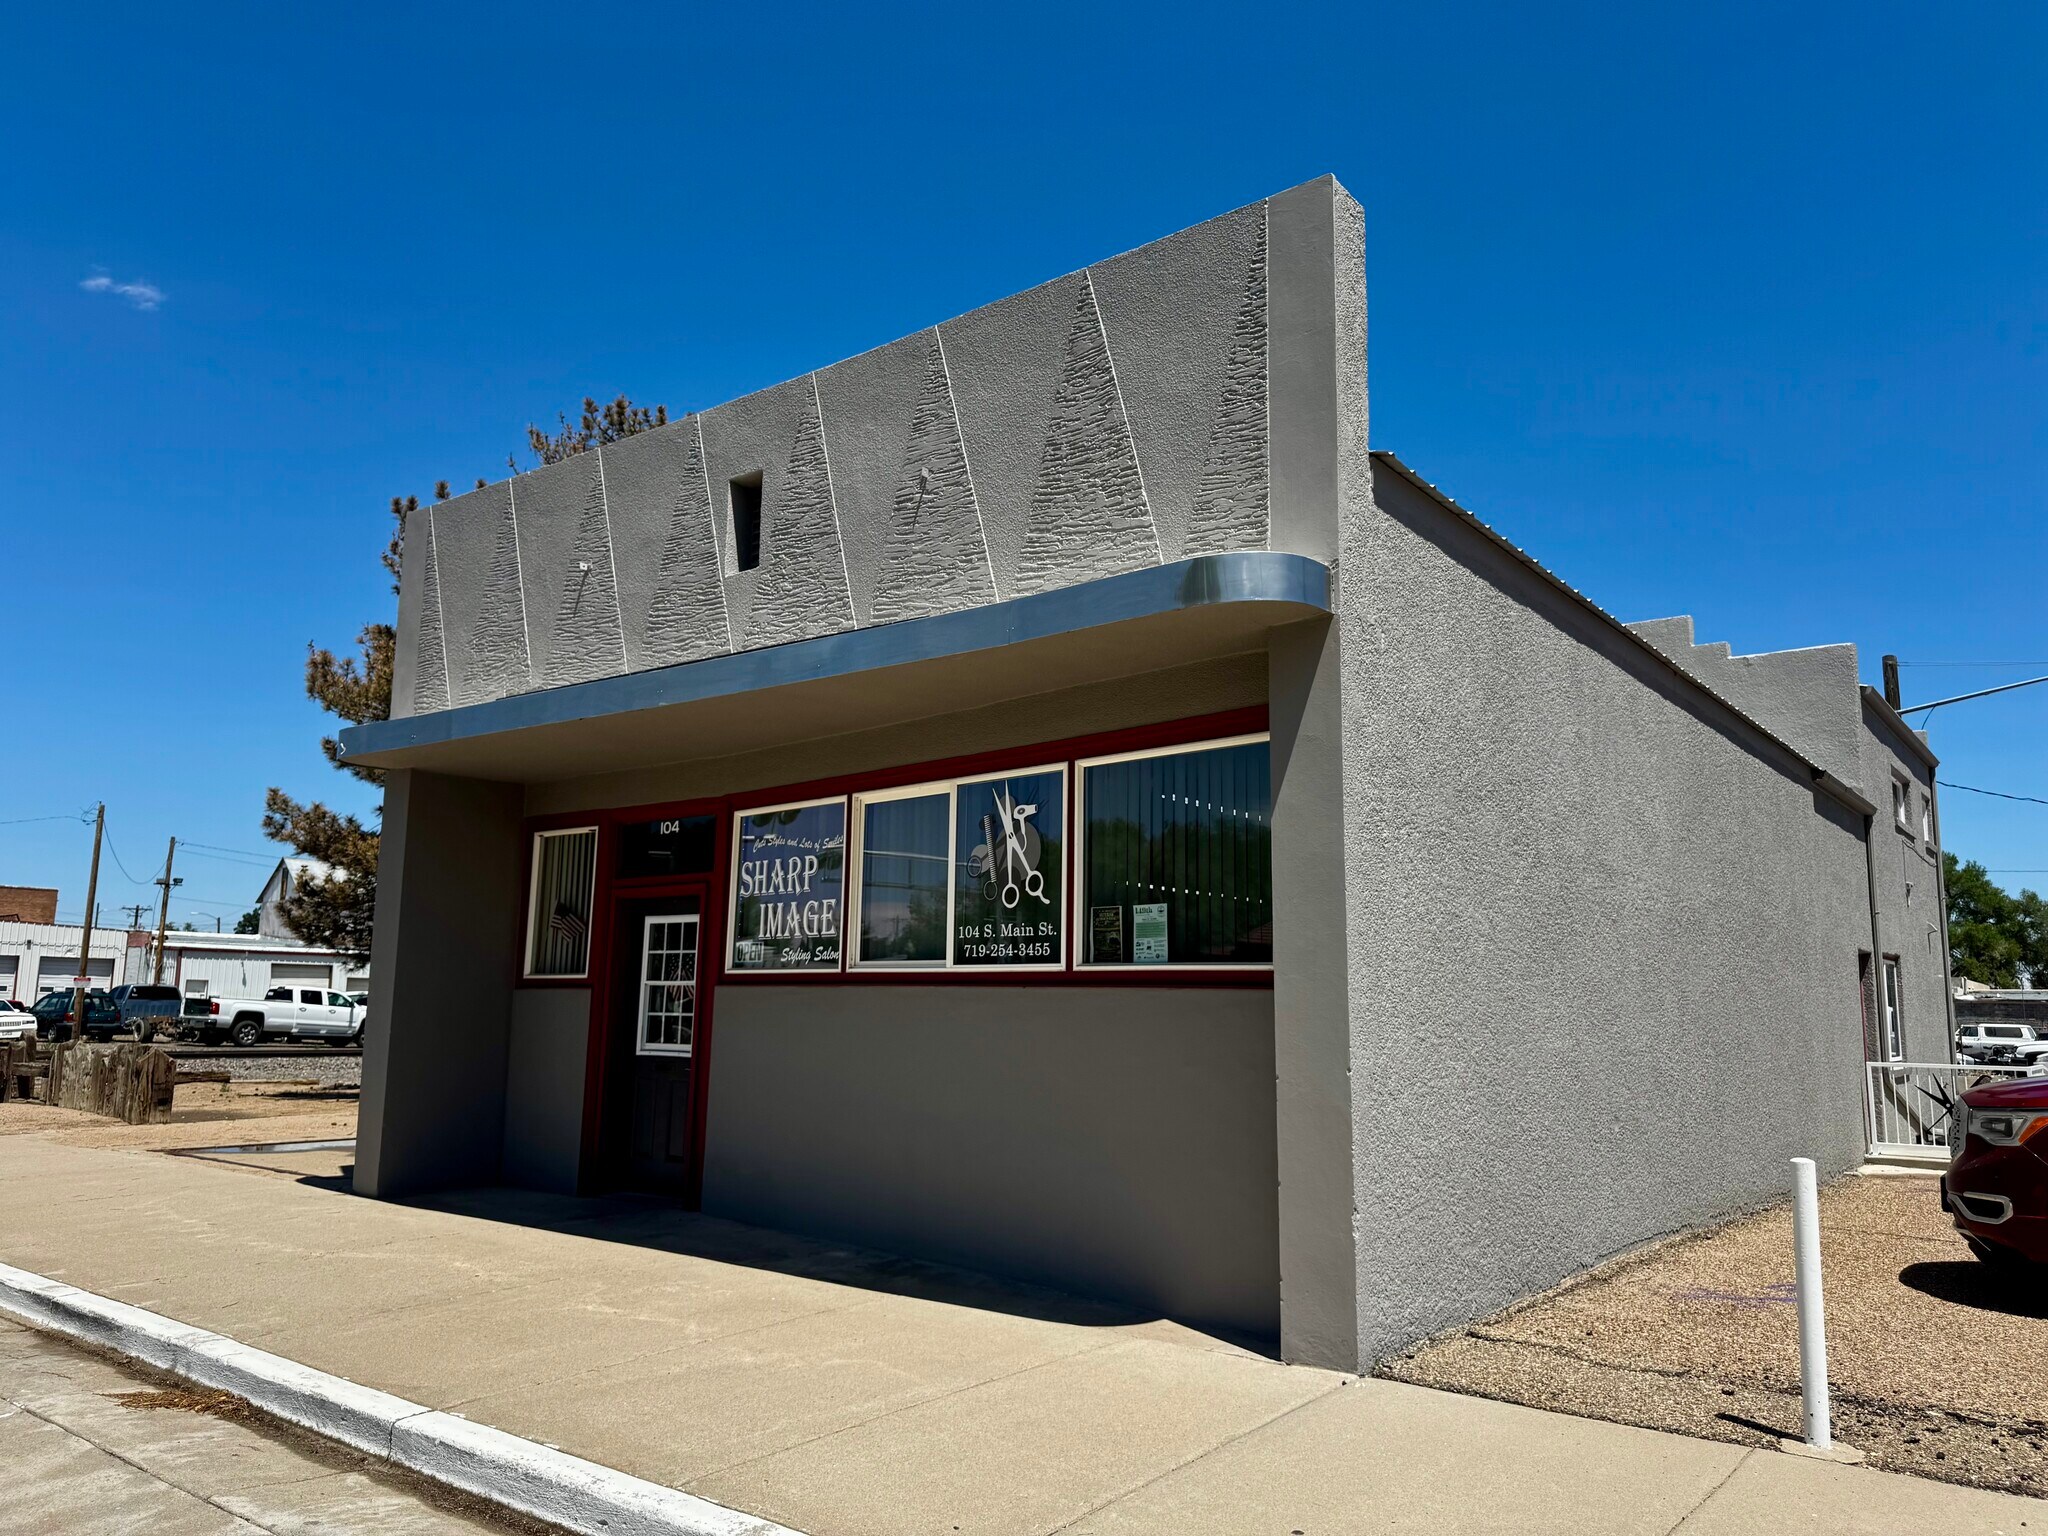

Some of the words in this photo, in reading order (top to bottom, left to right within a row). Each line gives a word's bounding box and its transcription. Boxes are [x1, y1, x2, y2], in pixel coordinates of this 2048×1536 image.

[660, 820, 680, 835] 104
[768, 835, 786, 847] Styles
[786, 837, 799, 847] and
[799, 837, 813, 849] Lots
[814, 838, 821, 852] of
[740, 855, 819, 897] SHARP
[758, 899, 837, 940] IMAGE
[959, 925, 980, 939] 104
[983, 923, 996, 938] S.
[1000, 922, 1034, 937] Main
[1038, 921, 1057, 936] St.
[737, 943, 762, 961] OPEN
[780, 947, 811, 964] Styling
[813, 946, 840, 961] Salon
[963, 942, 1050, 957] 719-254-3455
